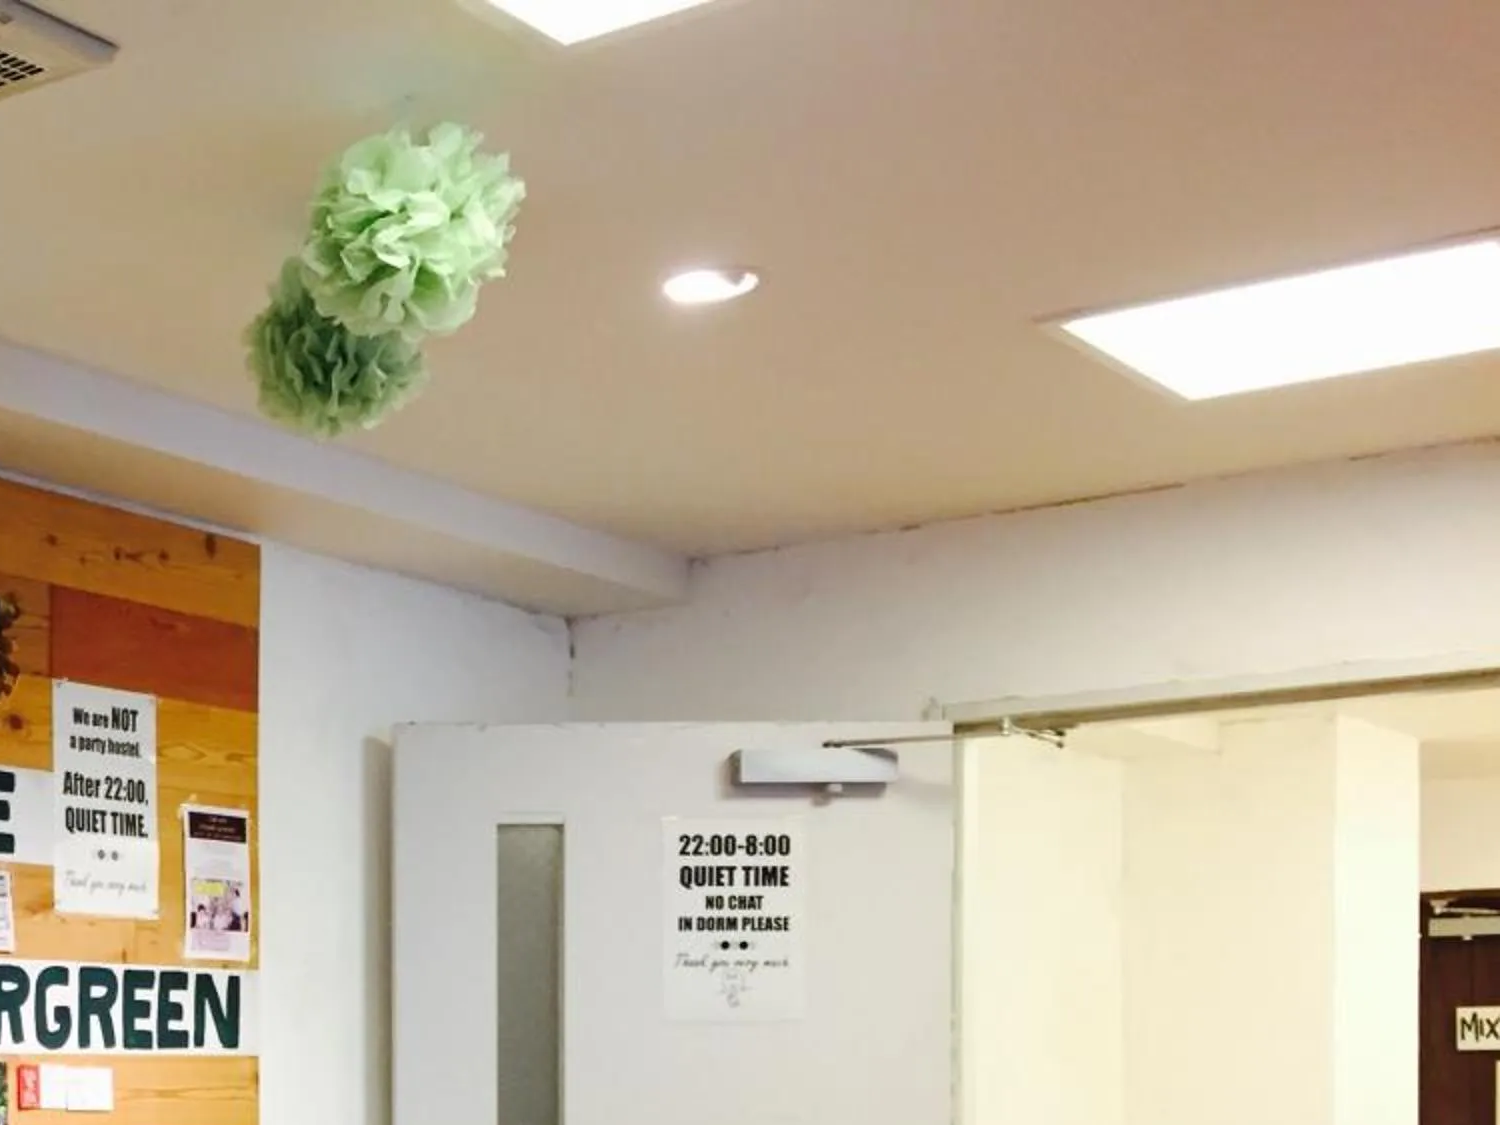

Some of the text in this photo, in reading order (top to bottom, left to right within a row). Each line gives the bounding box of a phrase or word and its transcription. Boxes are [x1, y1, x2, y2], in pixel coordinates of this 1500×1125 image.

[72, 706, 139, 732] We are NOT
[78, 736, 107, 756] party
[62, 770, 101, 799] After
[64, 805, 149, 839] QUIET TIME.
[678, 834, 791, 857] 22:00-8:00
[679, 865, 790, 890] QUIET TIME
[705, 895, 764, 911] NO CHAT
[678, 916, 790, 932] IN DORM PLEASE
